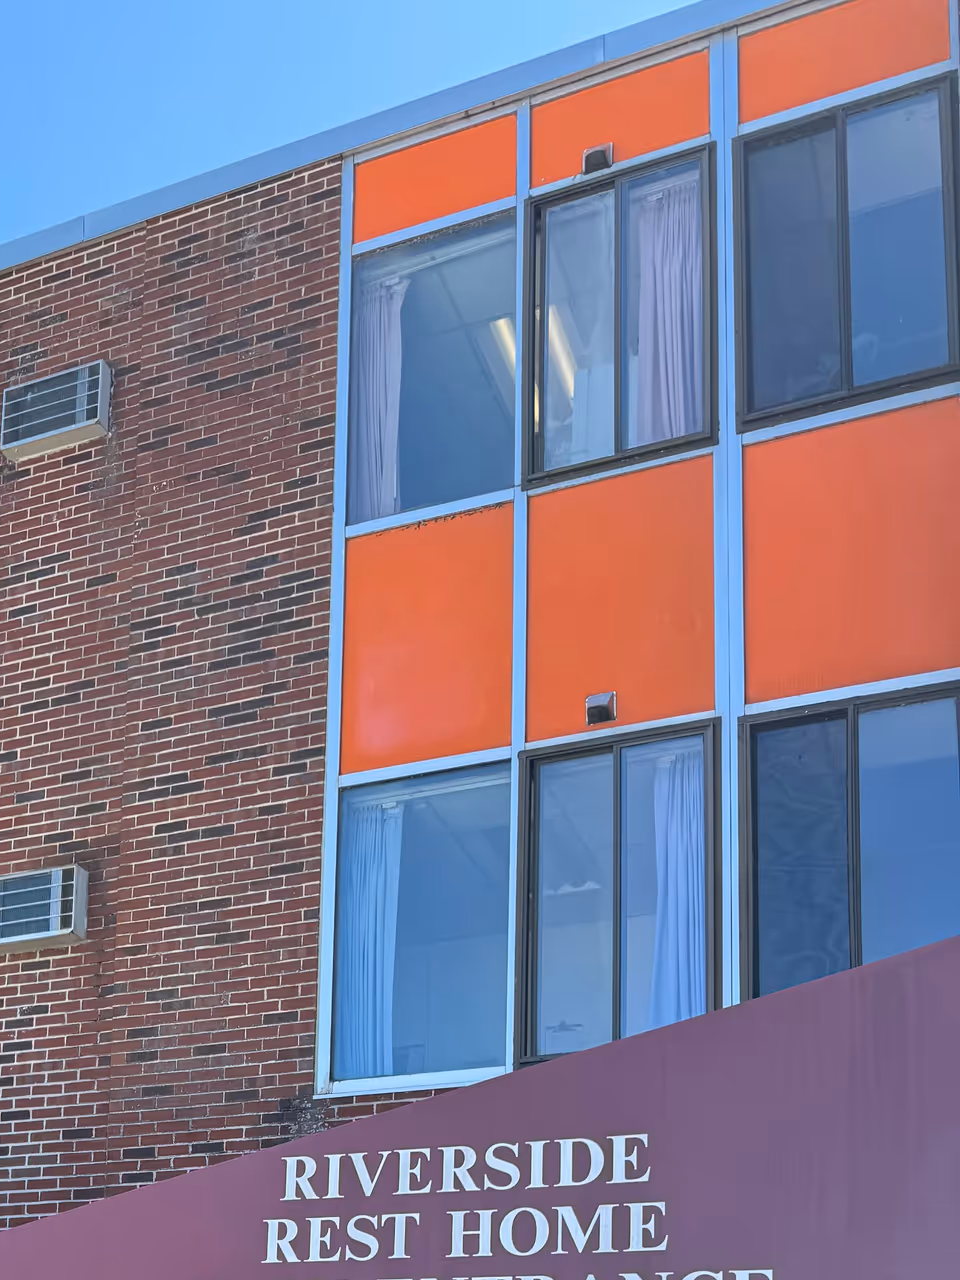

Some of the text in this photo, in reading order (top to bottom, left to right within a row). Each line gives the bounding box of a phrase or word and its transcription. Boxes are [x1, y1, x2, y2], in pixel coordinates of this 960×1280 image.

[280, 1134, 650, 1201] RIVERSIDE
[261, 1201, 668, 1264] REST HOME
